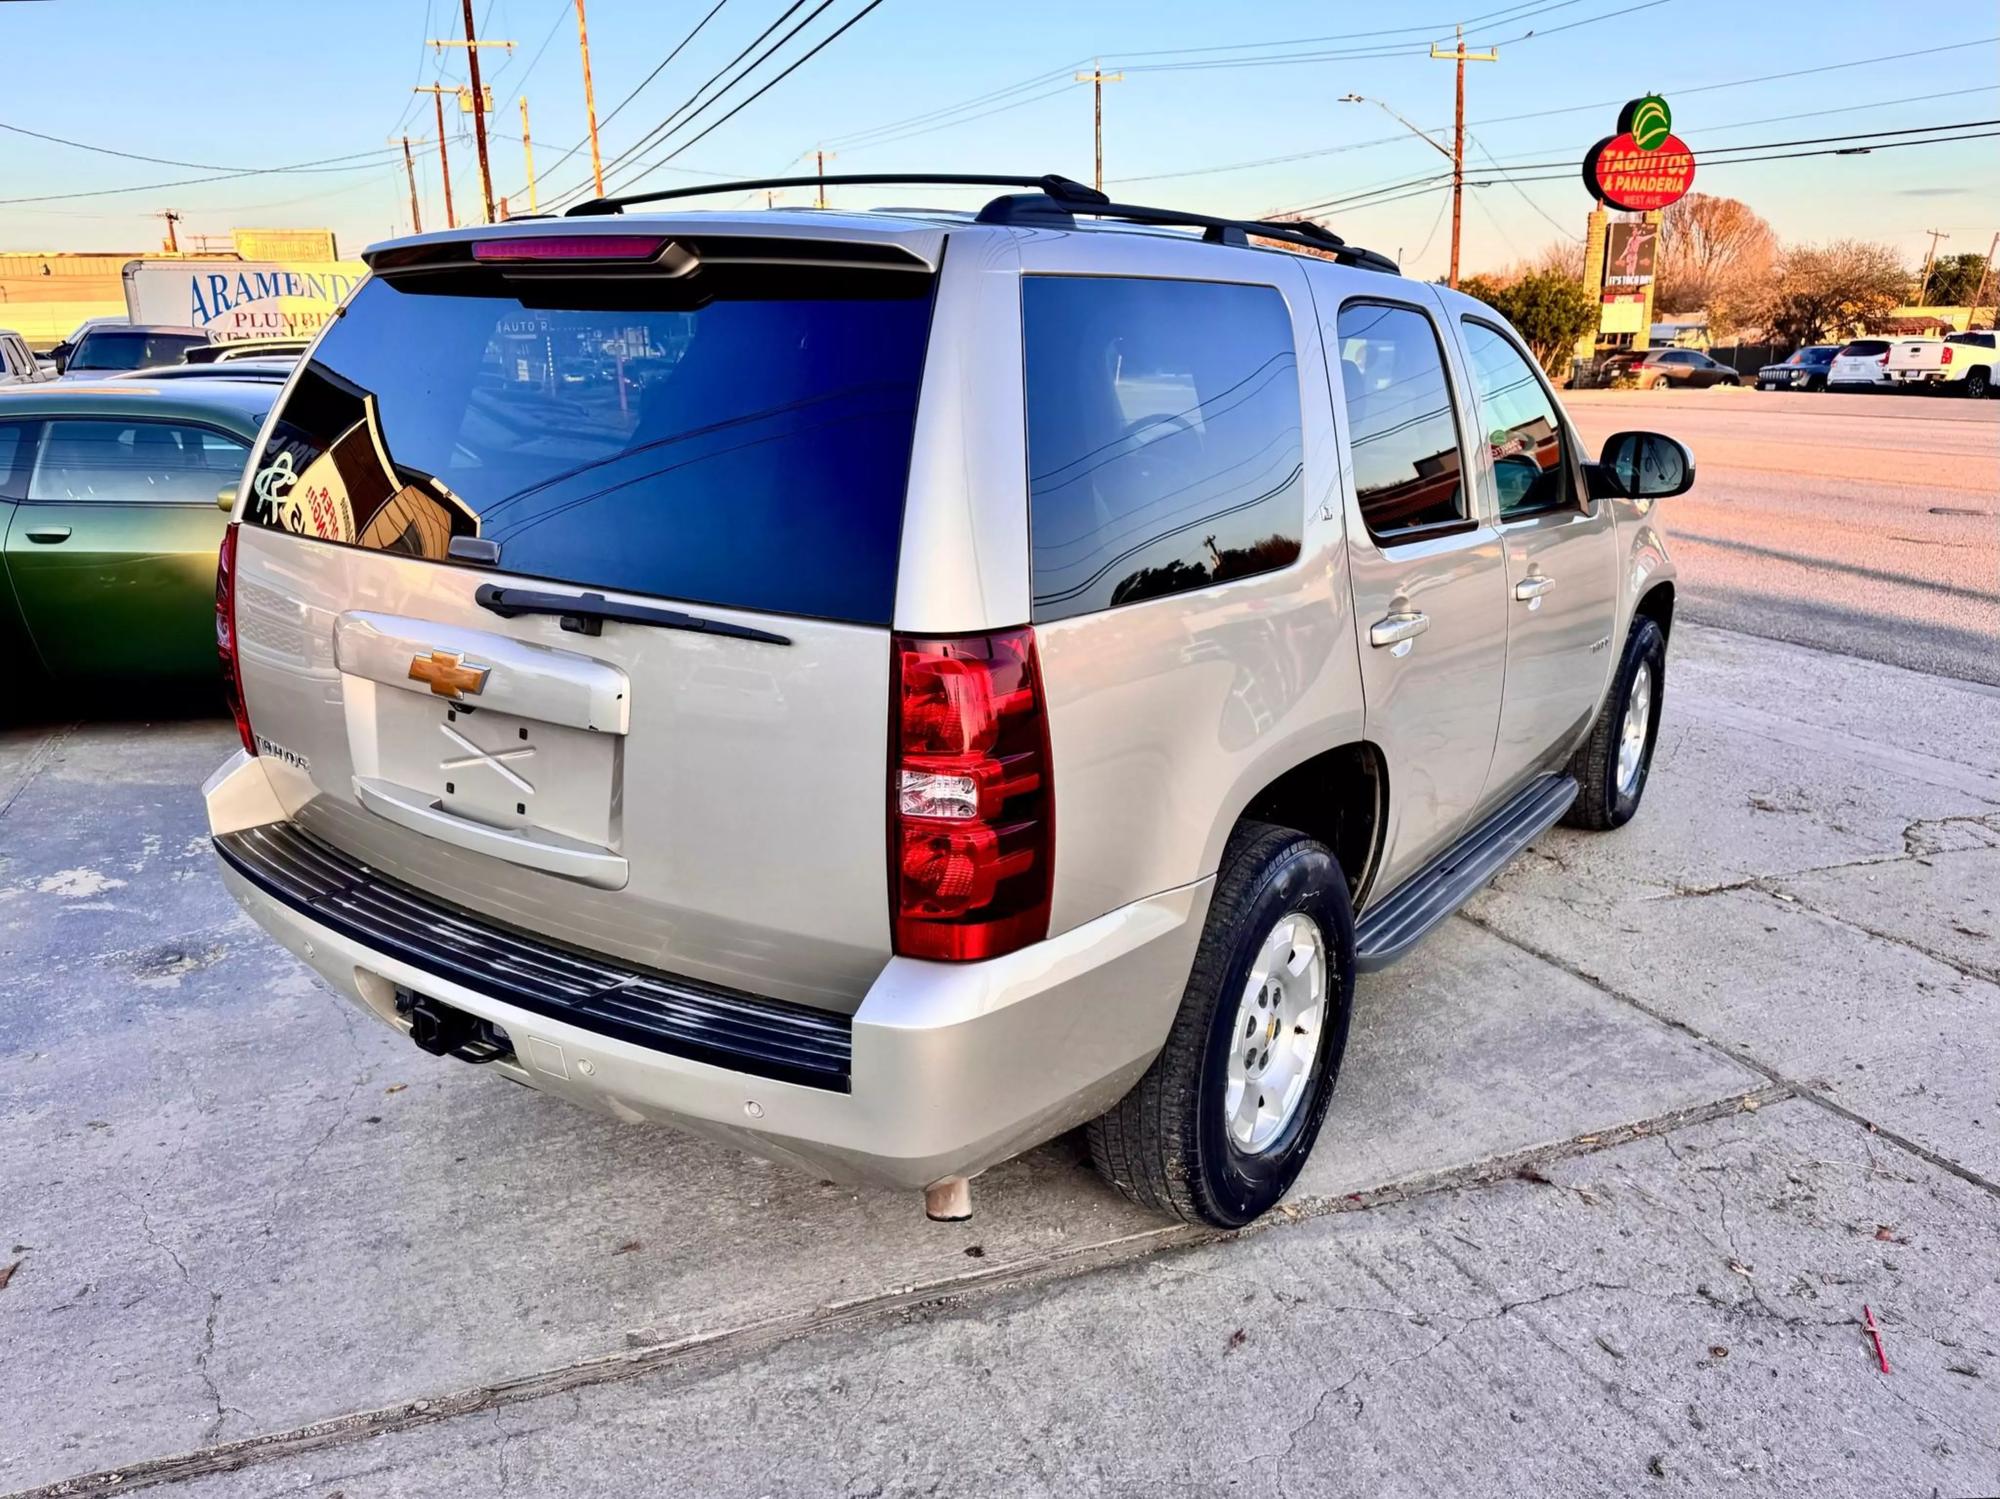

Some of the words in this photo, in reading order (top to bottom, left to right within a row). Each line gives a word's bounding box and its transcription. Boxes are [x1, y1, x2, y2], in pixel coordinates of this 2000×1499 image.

[1603, 149, 1690, 176] TAQUITOS
[1603, 174, 1613, 192] &
[1614, 175, 1684, 193] PANADERIA
[1624, 194, 1645, 206] WEST
[192, 272, 362, 328] ARAMEND
[234, 312, 331, 328] PLUMBI
[503, 321, 536, 332] AUTO
